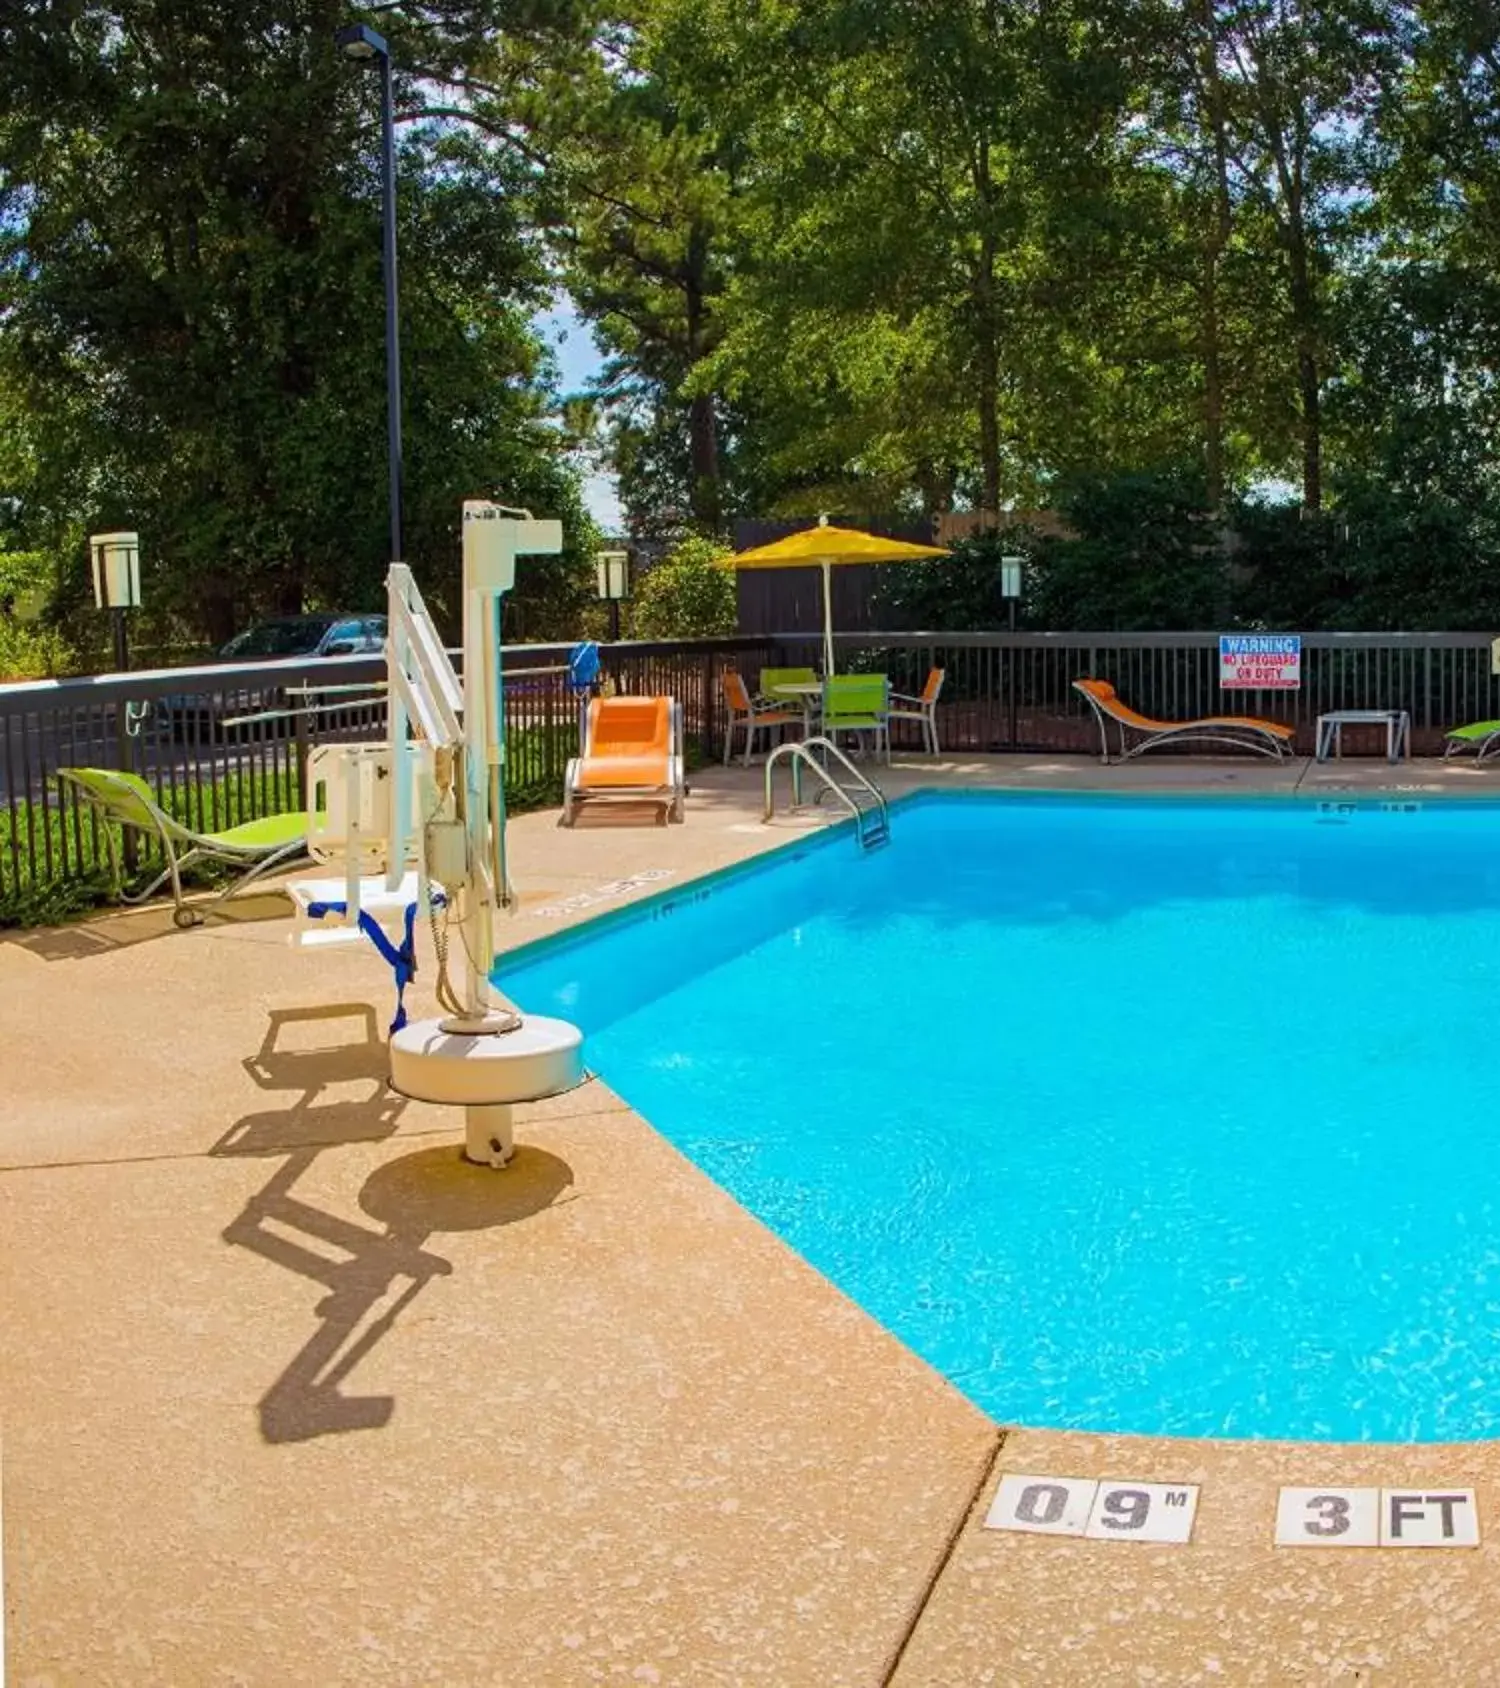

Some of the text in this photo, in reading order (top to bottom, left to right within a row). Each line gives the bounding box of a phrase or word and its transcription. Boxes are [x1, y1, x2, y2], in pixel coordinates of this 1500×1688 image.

[1227, 639, 1293, 653] WARNING
[1304, 1495, 1467, 1538] 3 FT
